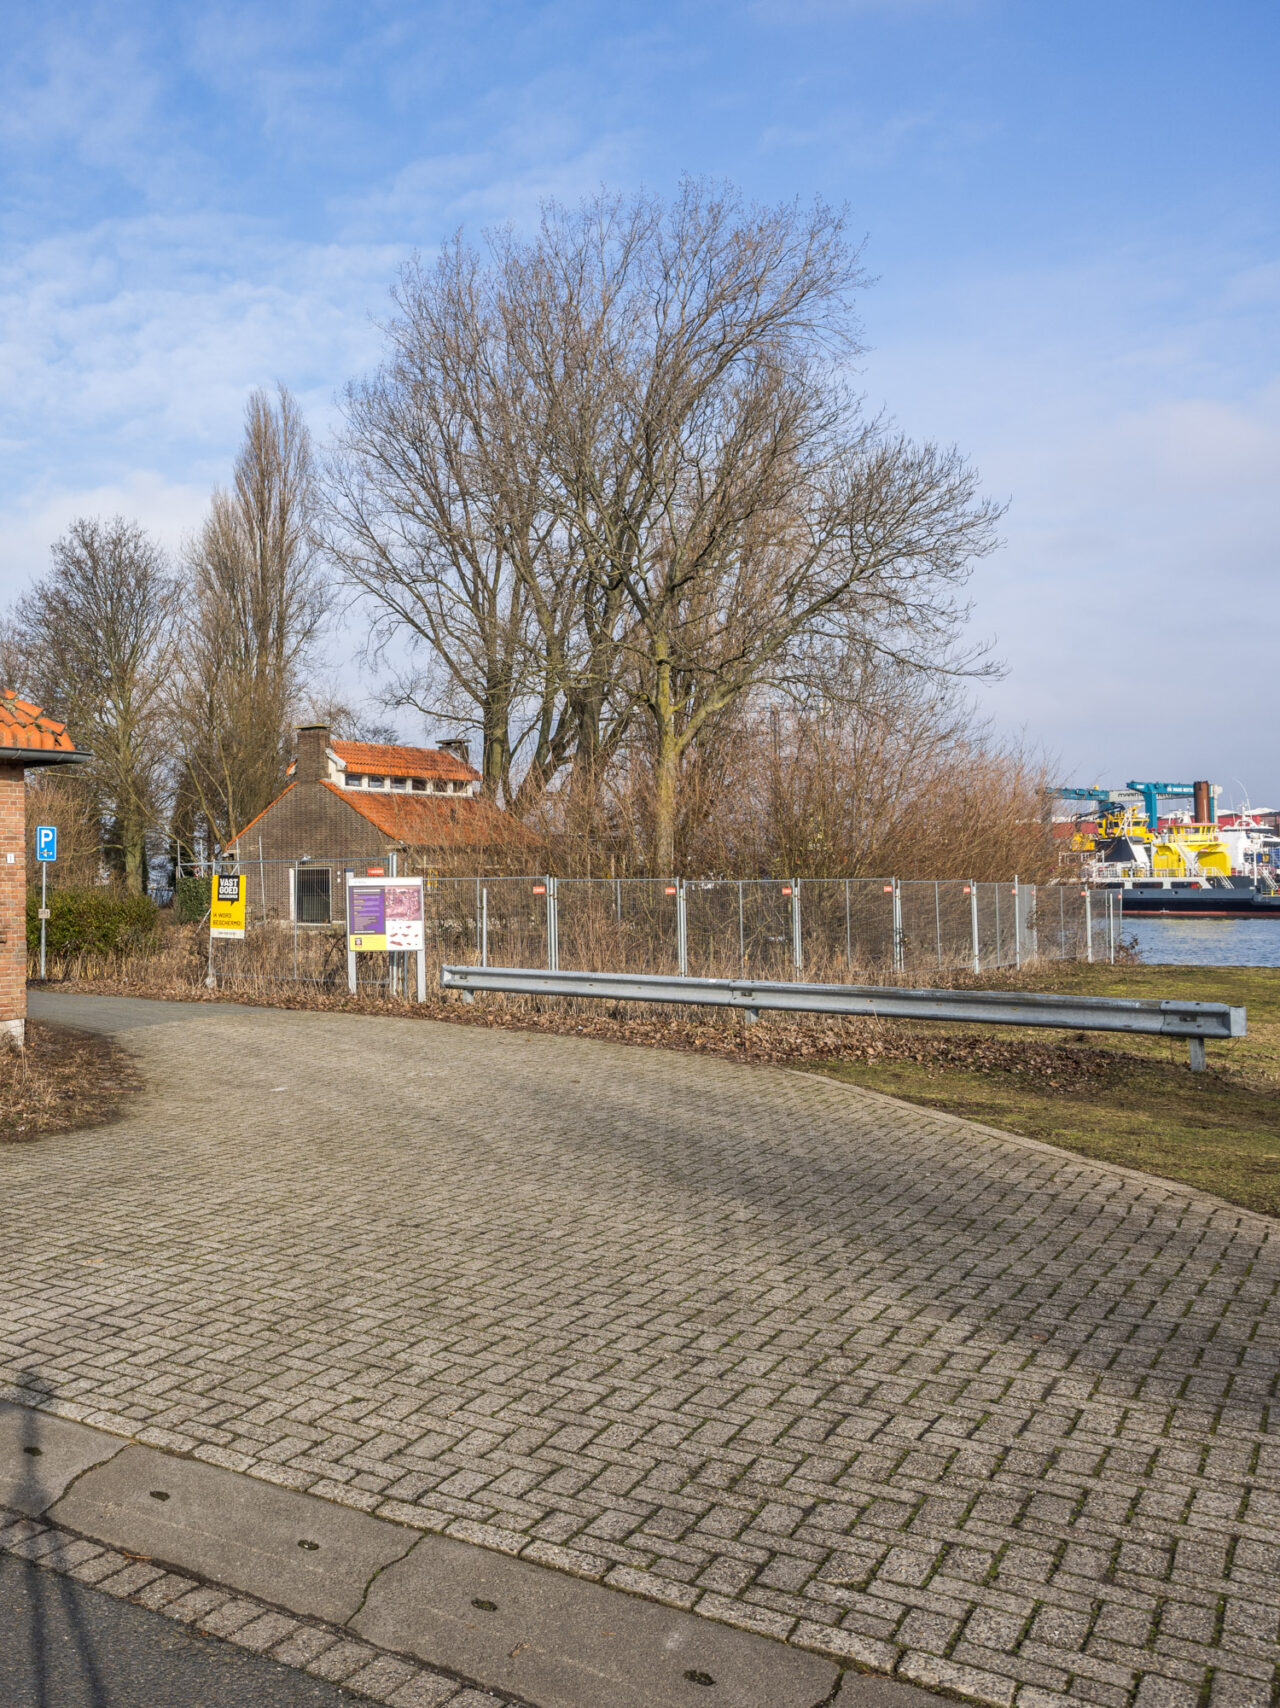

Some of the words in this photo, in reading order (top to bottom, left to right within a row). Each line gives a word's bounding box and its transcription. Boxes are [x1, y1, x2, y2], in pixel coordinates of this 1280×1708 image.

[41, 830, 53, 848] P
[219, 878, 238, 887] VAST
[219, 886, 238, 894] GOED
